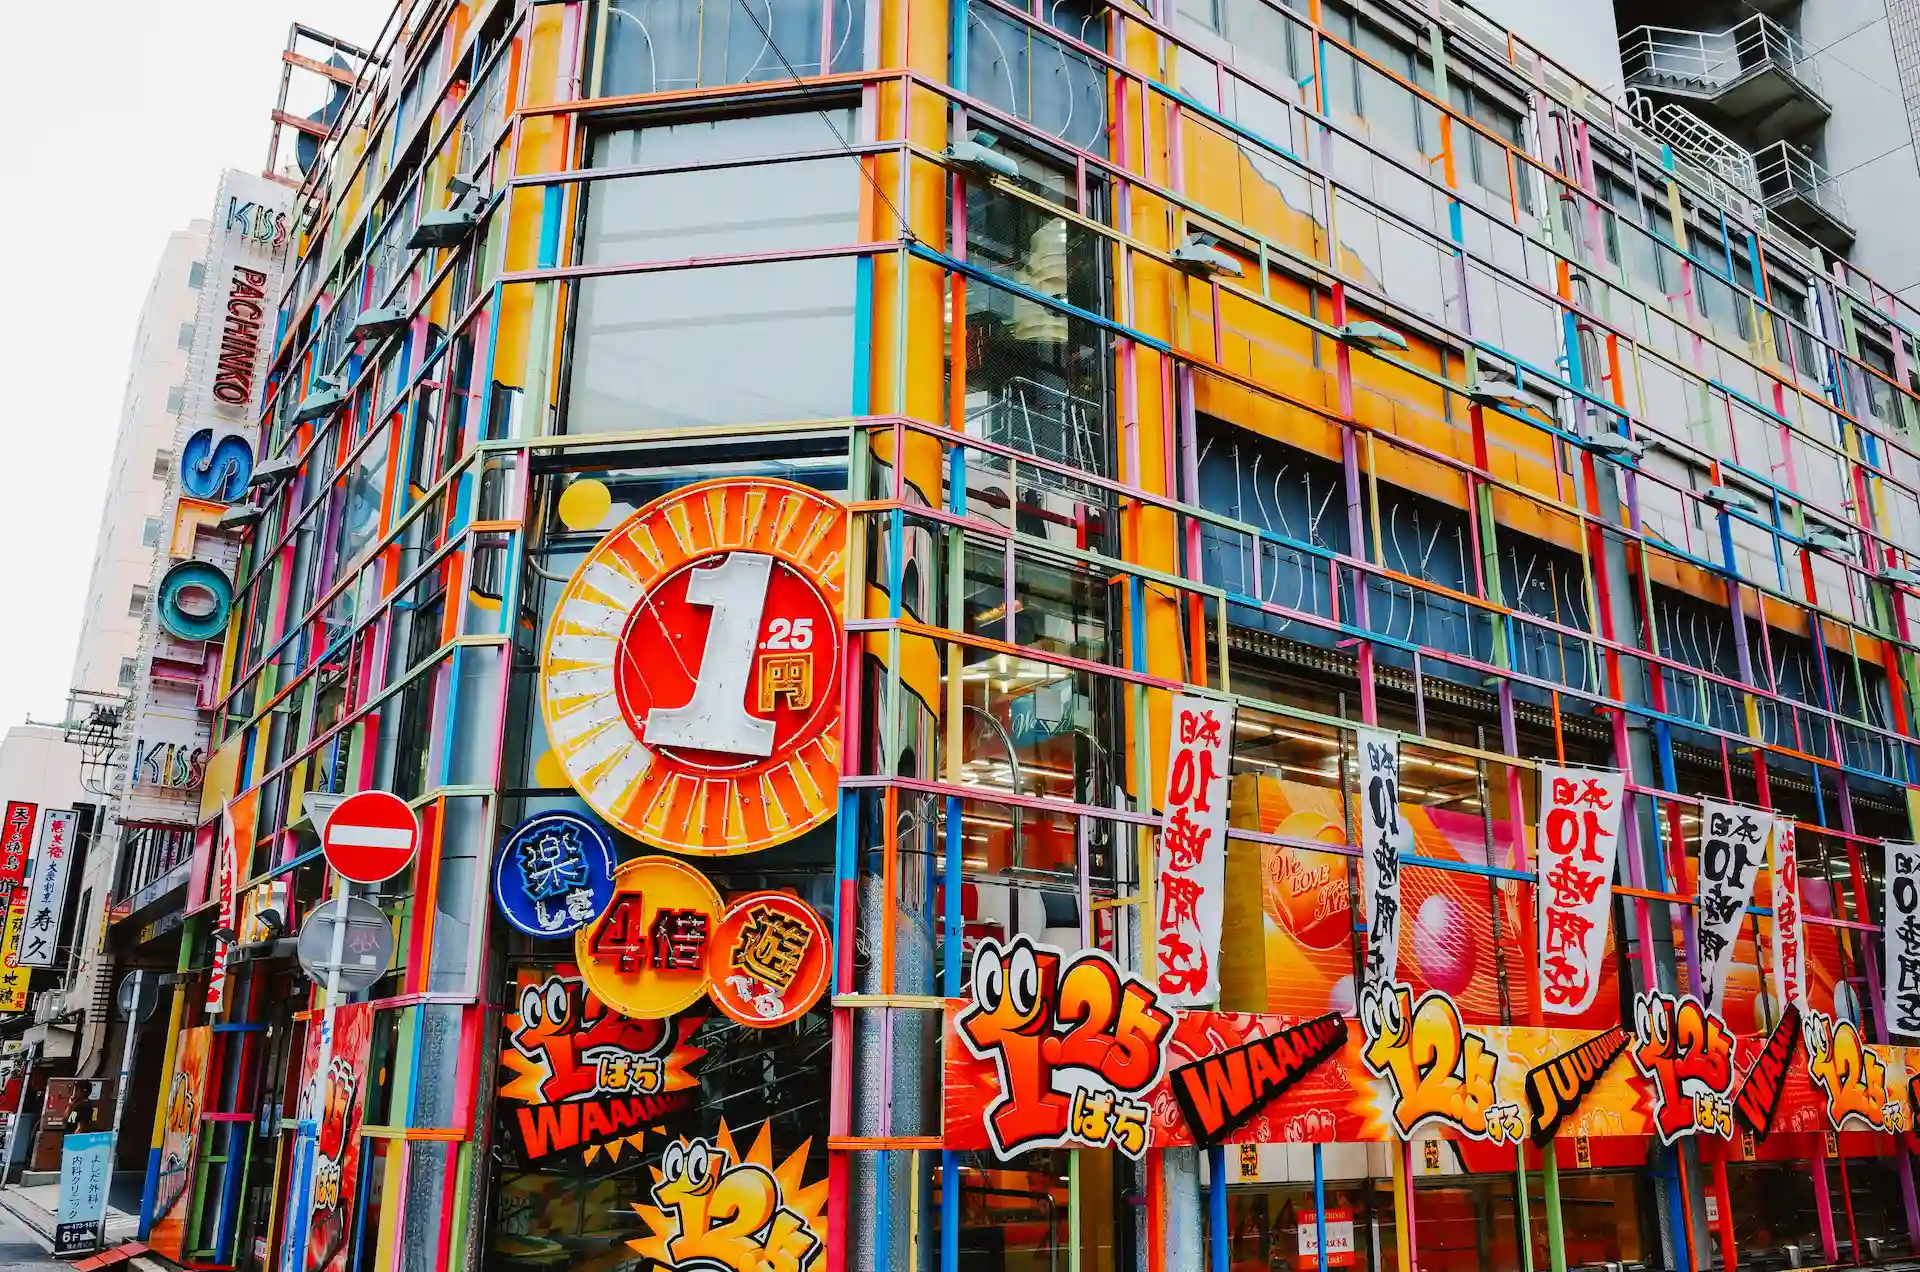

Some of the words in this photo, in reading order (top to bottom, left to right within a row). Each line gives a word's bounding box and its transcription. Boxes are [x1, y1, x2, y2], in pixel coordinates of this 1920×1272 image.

[226, 196, 288, 247] KISS
[211, 264, 268, 405] PACHINKO
[149, 427, 254, 710] SLOT
[133, 739, 203, 790] KISS
[3, 806, 29, 870] 天下の焼鳥
[24, 908, 56, 960] 寿久
[588, 890, 710, 975] 4倍
[599, 1056, 661, 1094] ぱち
[1072, 1086, 1151, 1159] ぱち
[1694, 1090, 1735, 1141] ぱち
[68, 1155, 82, 1219] 内科クリニック
[62, 1231, 79, 1243] 6F
